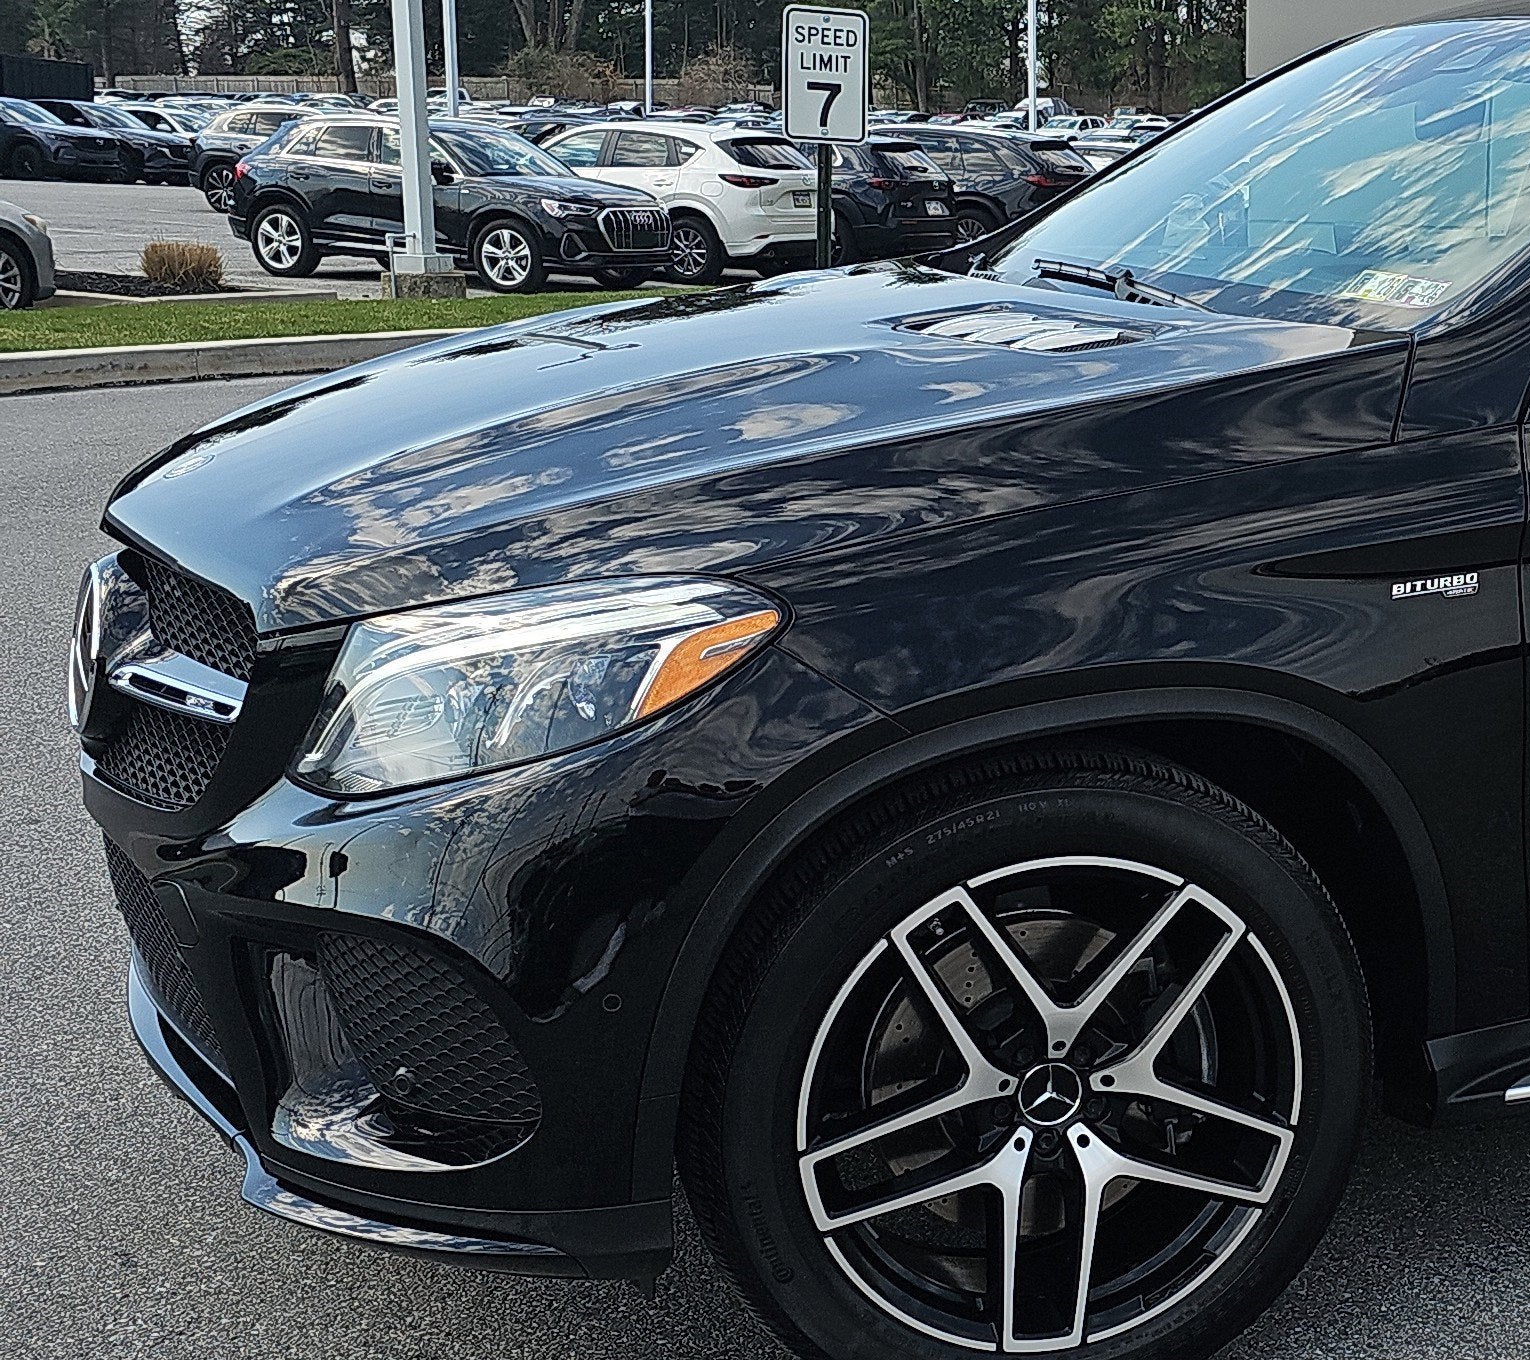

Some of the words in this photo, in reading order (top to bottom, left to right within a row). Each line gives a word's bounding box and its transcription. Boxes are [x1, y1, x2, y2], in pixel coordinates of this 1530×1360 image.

[794, 25, 858, 48] SPEED
[800, 51, 851, 74] LIMIT
[806, 81, 842, 128] 7
[1391, 572, 1479, 596] BITURBO
[885, 846, 914, 868] M+S
[925, 809, 1001, 845] 275/45R21
